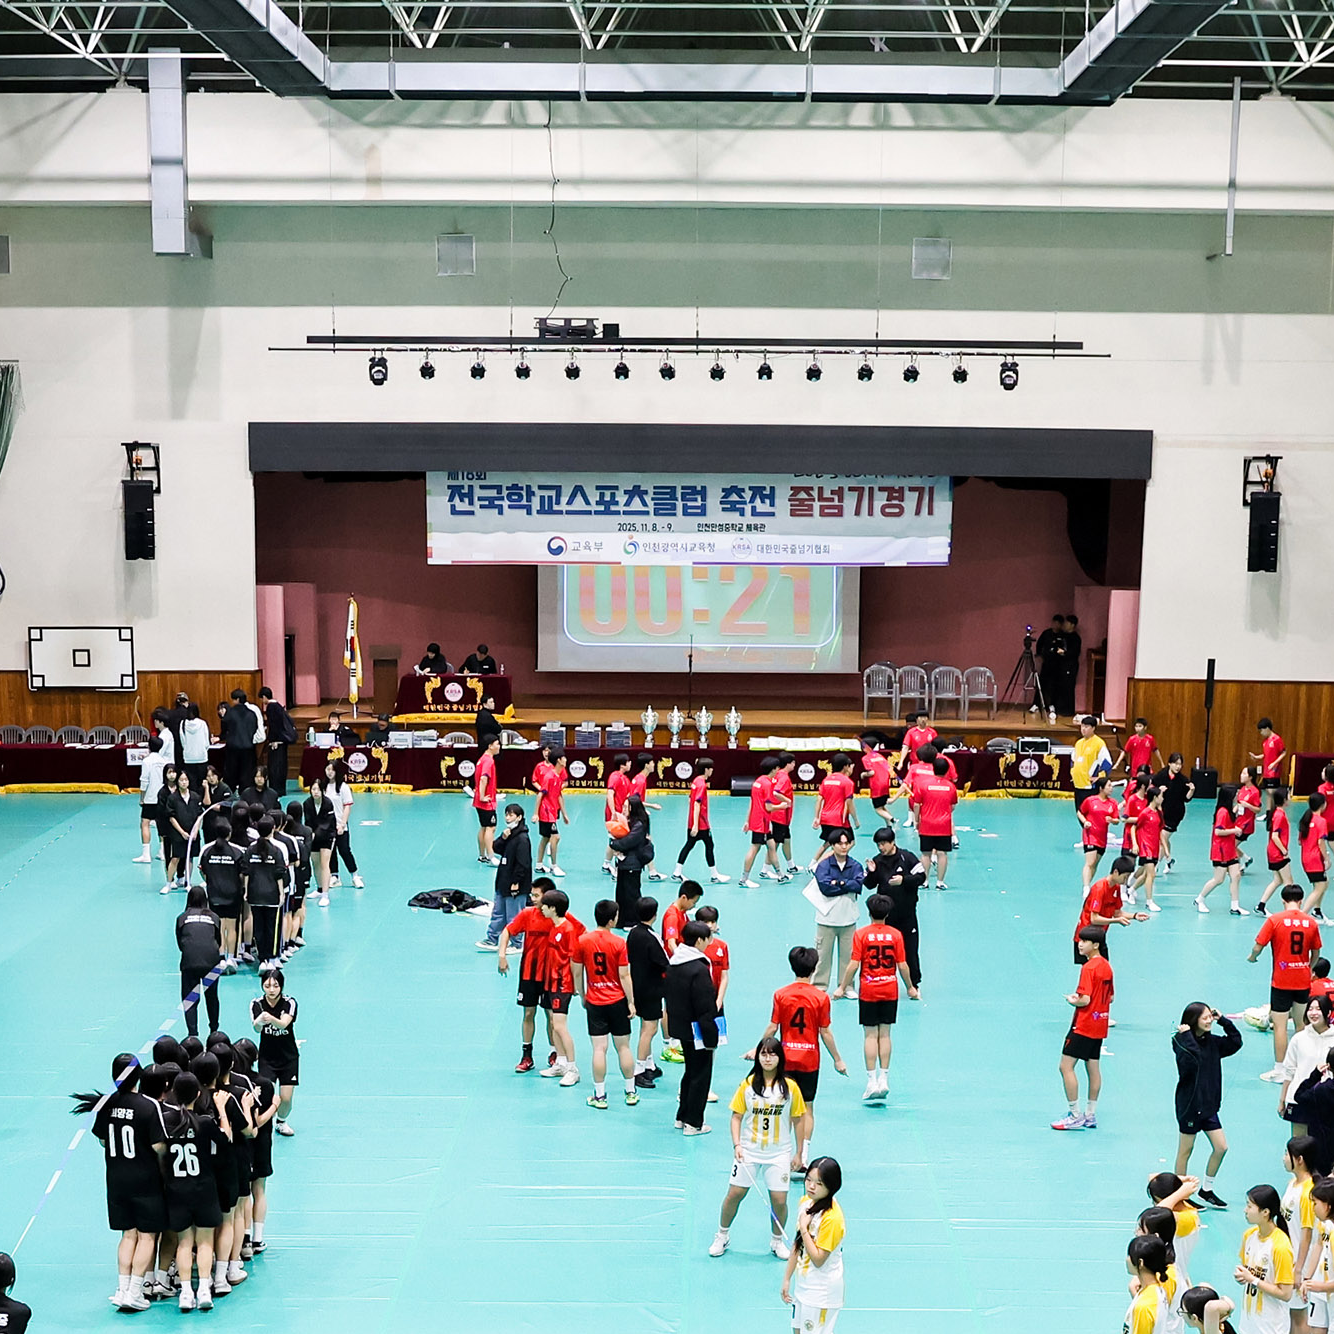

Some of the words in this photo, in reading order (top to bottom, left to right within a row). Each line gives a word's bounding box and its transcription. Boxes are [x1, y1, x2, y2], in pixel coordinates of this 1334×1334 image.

[447, 485, 707, 517] 전국학교스포츠클럽
[719, 485, 776, 517] 축전
[788, 486, 935, 517] 줄넘기경기
[571, 541, 604, 552] 교육부
[642, 540, 716, 553] 인천광역시교육청
[756, 544, 830, 555] 대한민국줄넘기협회
[579, 566, 810, 635] 00:21
[1291, 931, 1304, 955] 8
[594, 952, 607, 976] 9
[867, 945, 894, 970] 35
[790, 1007, 806, 1035] 4
[762, 1117, 770, 1131] 3
[108, 1123, 136, 1159] 10
[170, 1143, 200, 1178] 26
